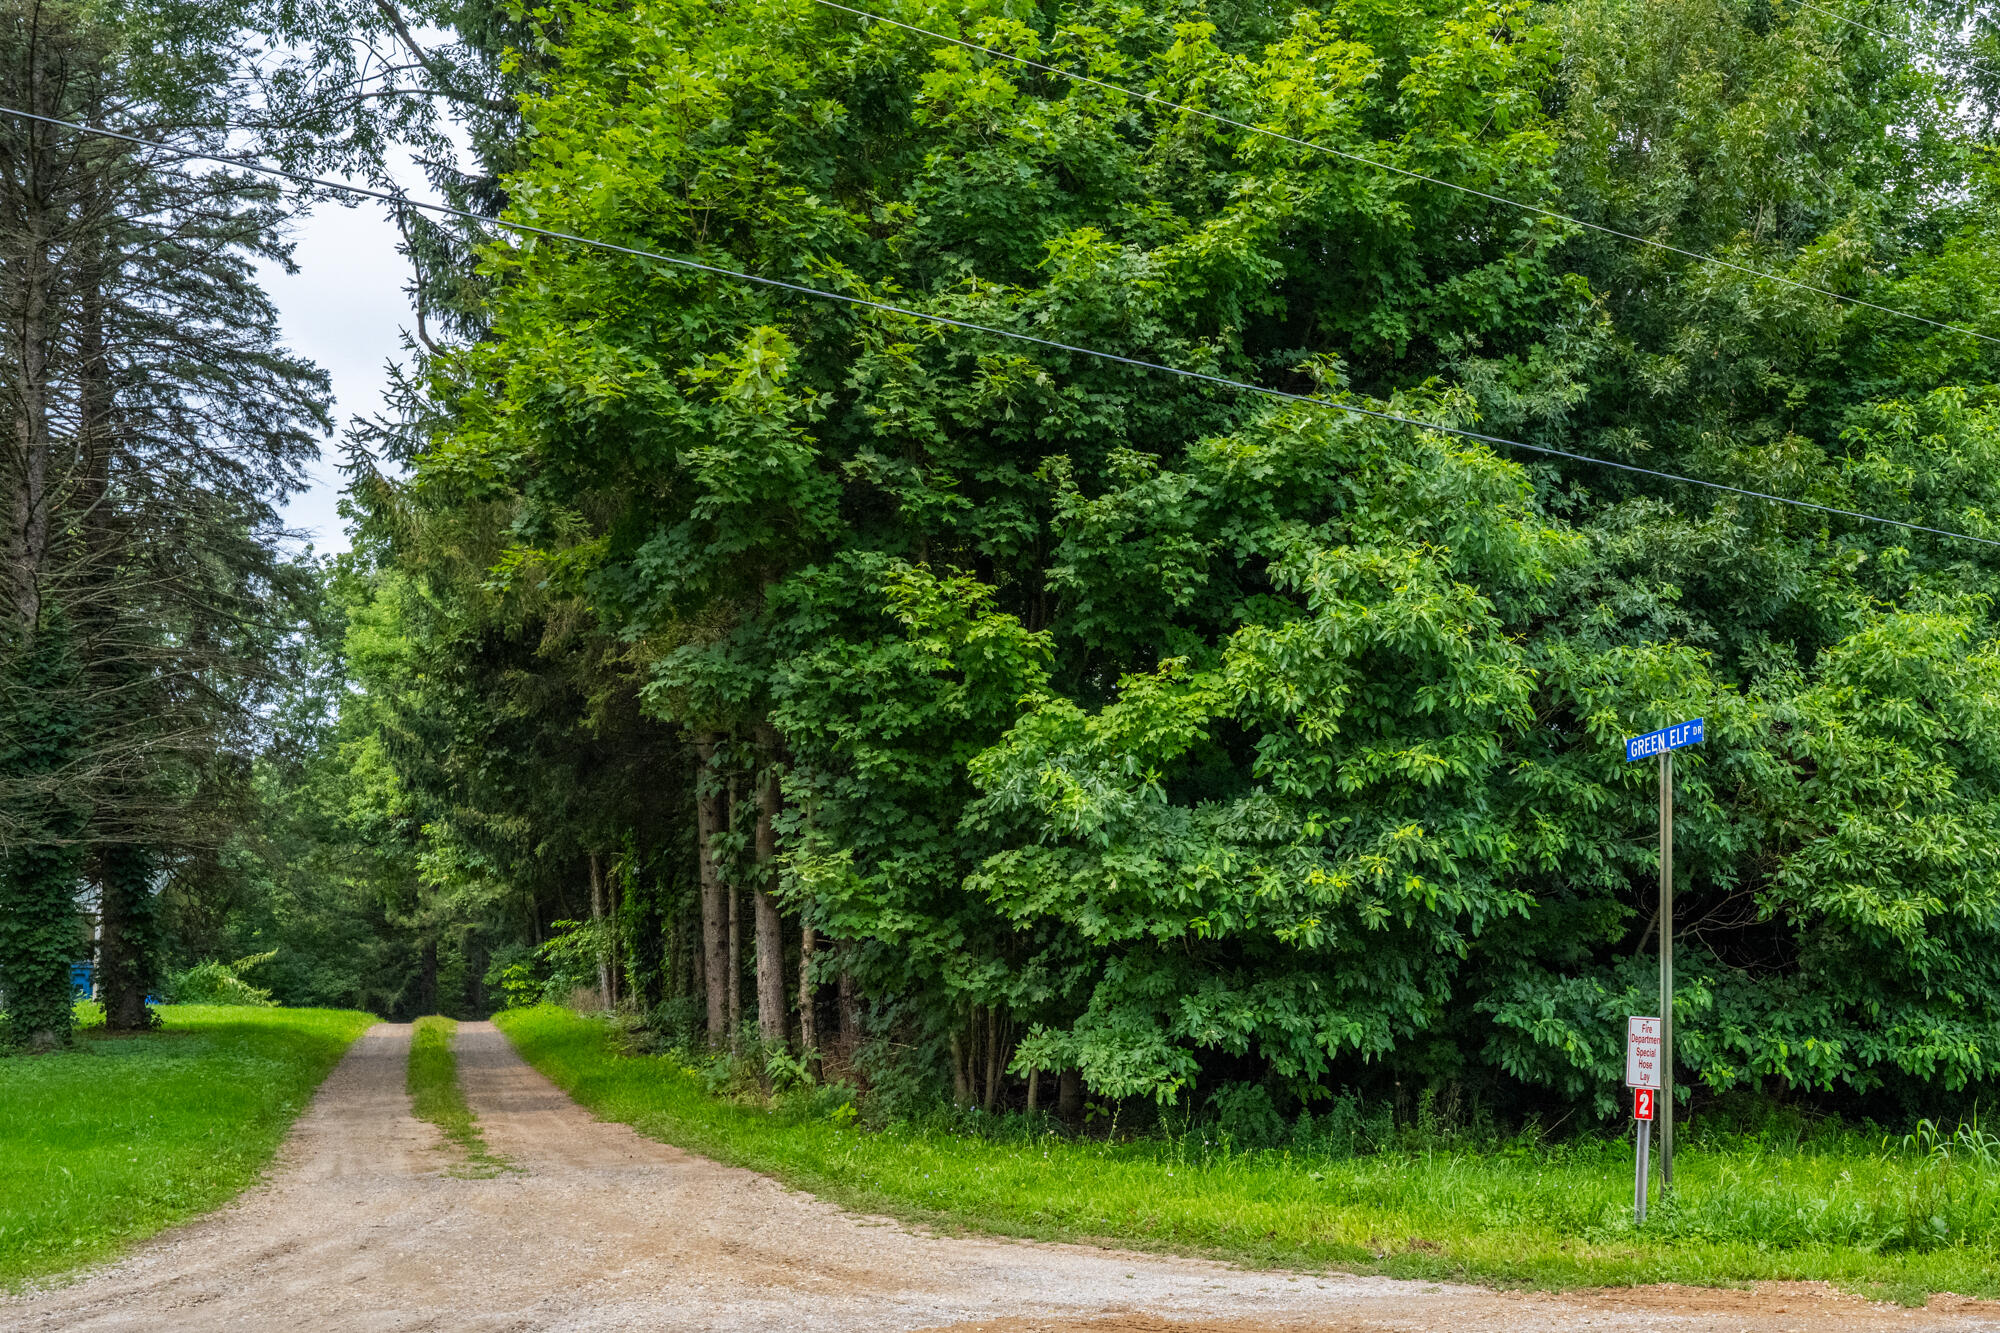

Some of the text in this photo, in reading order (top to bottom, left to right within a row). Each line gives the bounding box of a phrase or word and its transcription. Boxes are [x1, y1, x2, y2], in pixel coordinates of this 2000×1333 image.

[1631, 725, 1702, 757] GREEN ELF DR
[1641, 1024, 1652, 1033] Fire
[1631, 1034, 1661, 1045] Departmen
[1636, 1047, 1656, 1058] Special
[1638, 1059, 1653, 1069] Hose
[1640, 1071, 1650, 1083] Lay
[1639, 1093, 1649, 1115] 2
